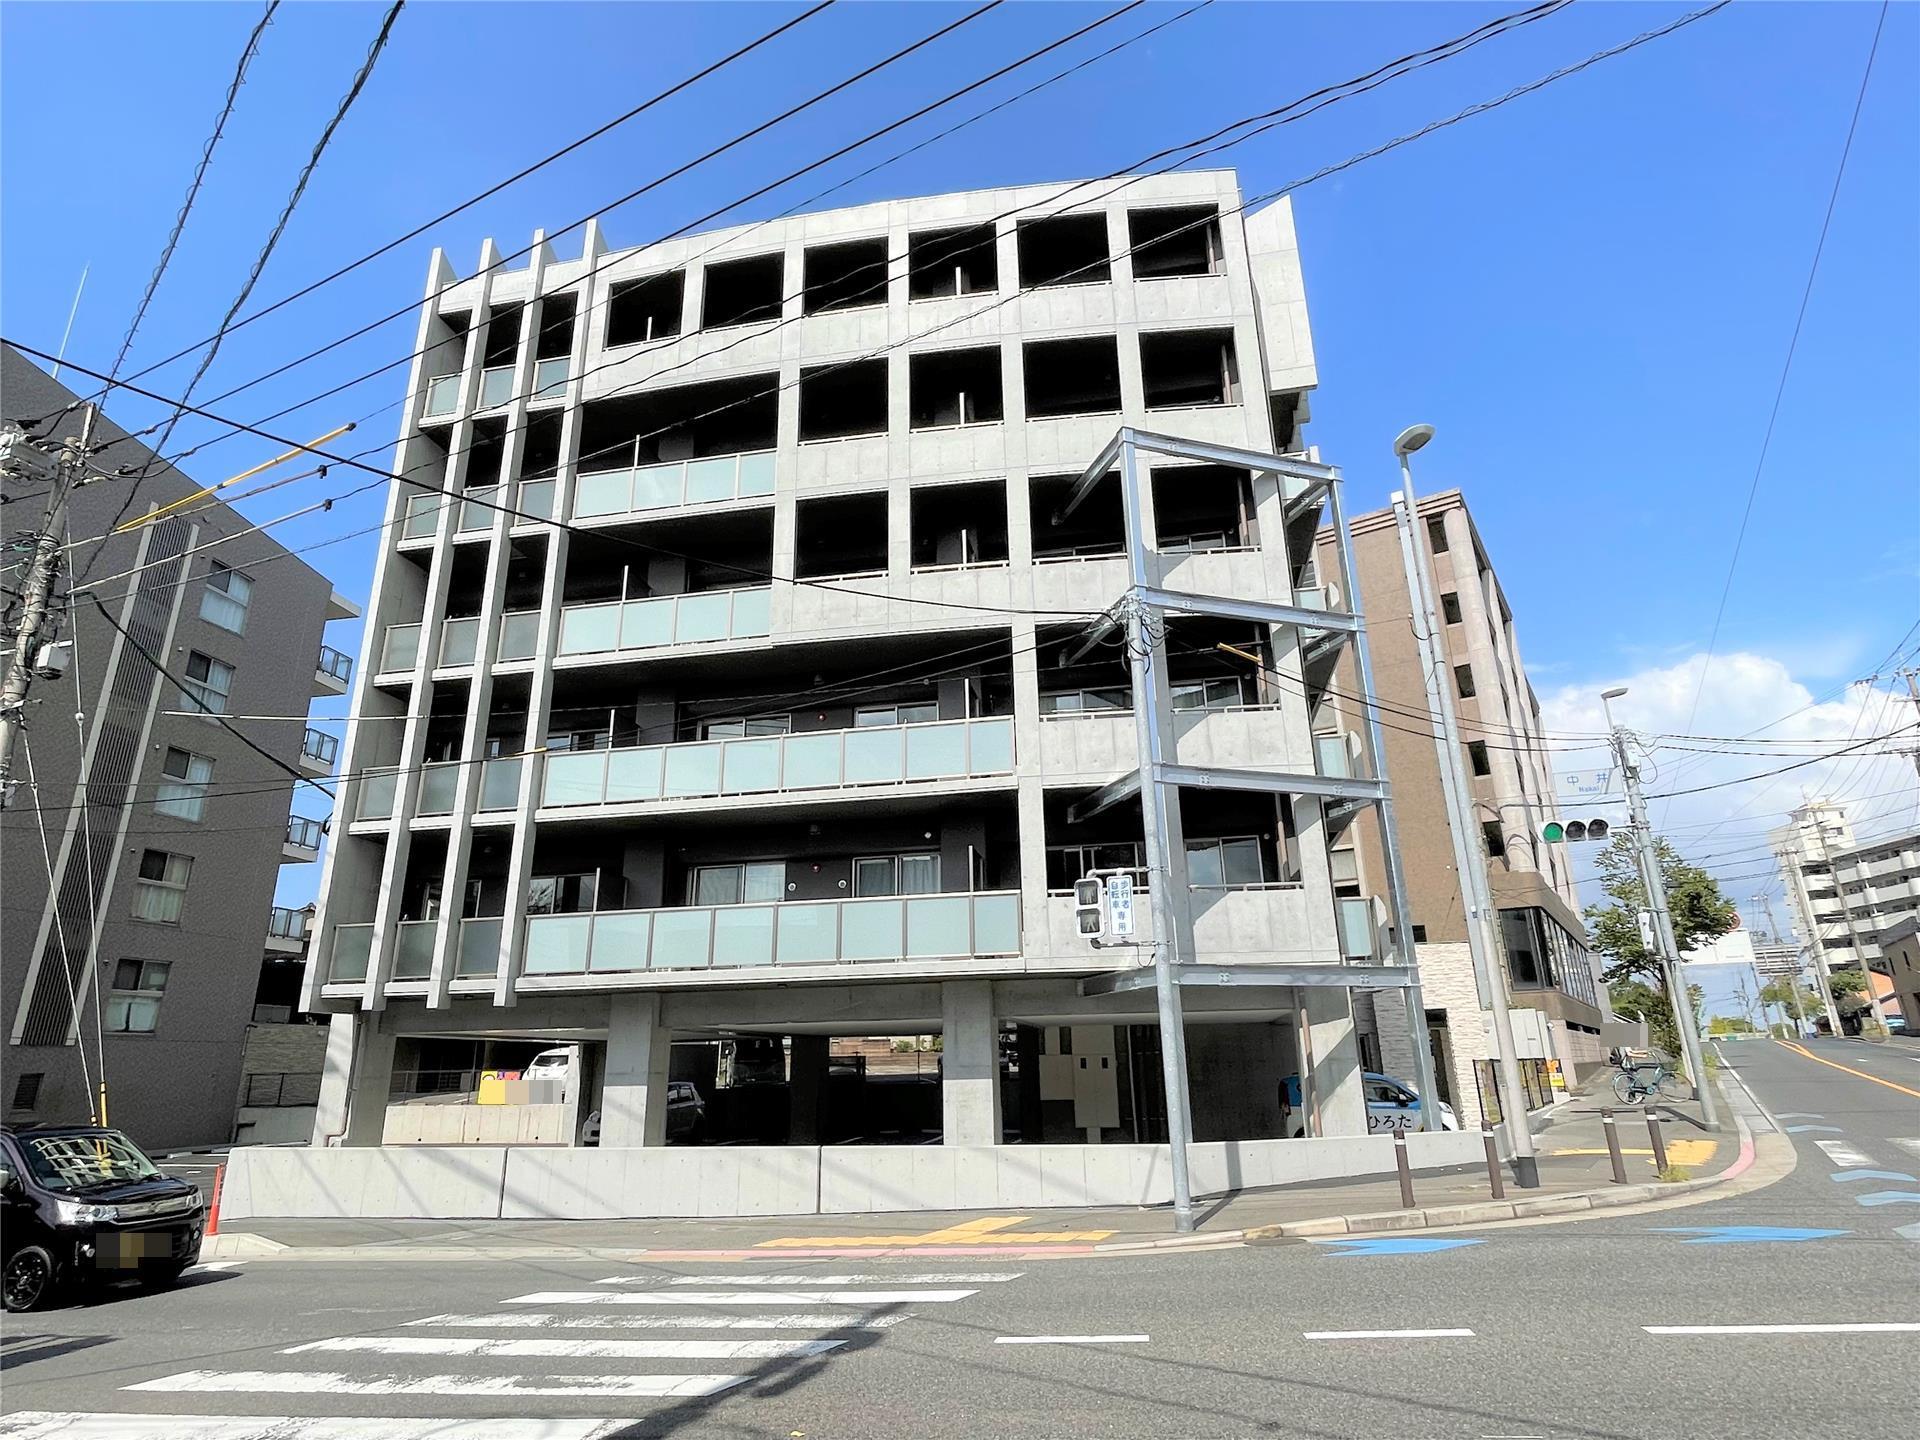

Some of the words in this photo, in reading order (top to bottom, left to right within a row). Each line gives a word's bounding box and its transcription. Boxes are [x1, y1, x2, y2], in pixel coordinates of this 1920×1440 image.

[1567, 773, 1608, 785] 中井
[1111, 881, 1120, 909] 自転車
[1120, 880, 1129, 909] 歩行者
[1118, 911, 1126, 932] 専用
[1369, 1113, 1412, 1129] ひろた
